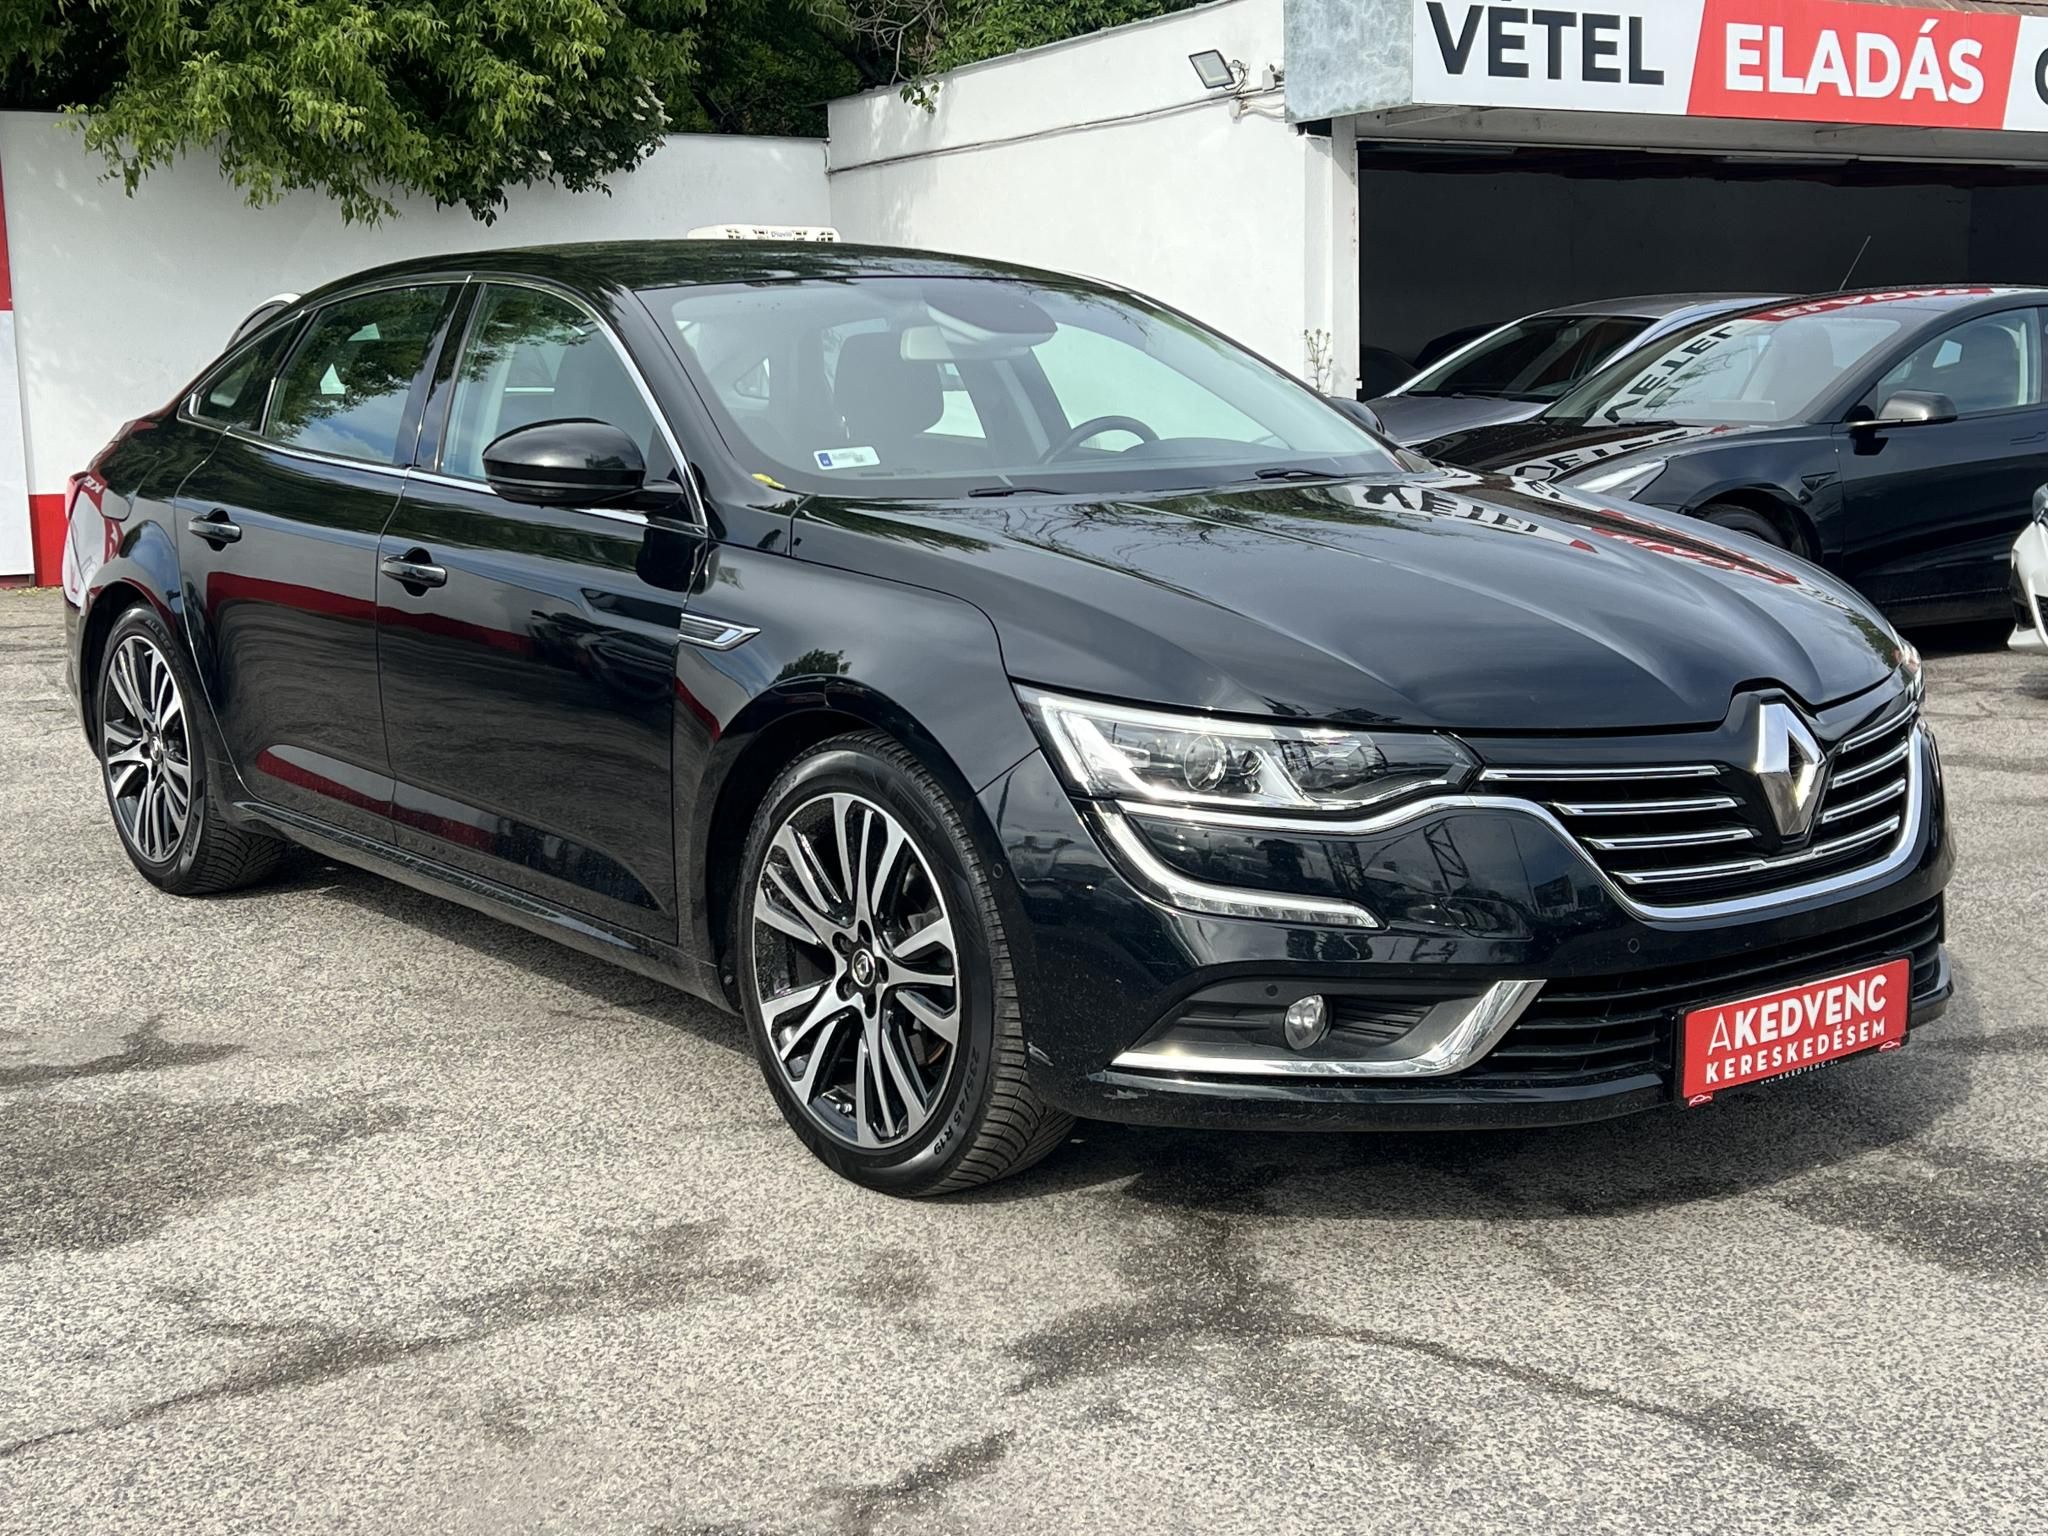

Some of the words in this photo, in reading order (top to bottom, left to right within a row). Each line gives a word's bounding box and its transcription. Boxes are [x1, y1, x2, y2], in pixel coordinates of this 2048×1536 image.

[1725, 19, 1985, 105] ELADÁS
[1705, 1017, 1885, 1085] KERESKEDÉSEM
[933, 1125, 954, 1155] R19
